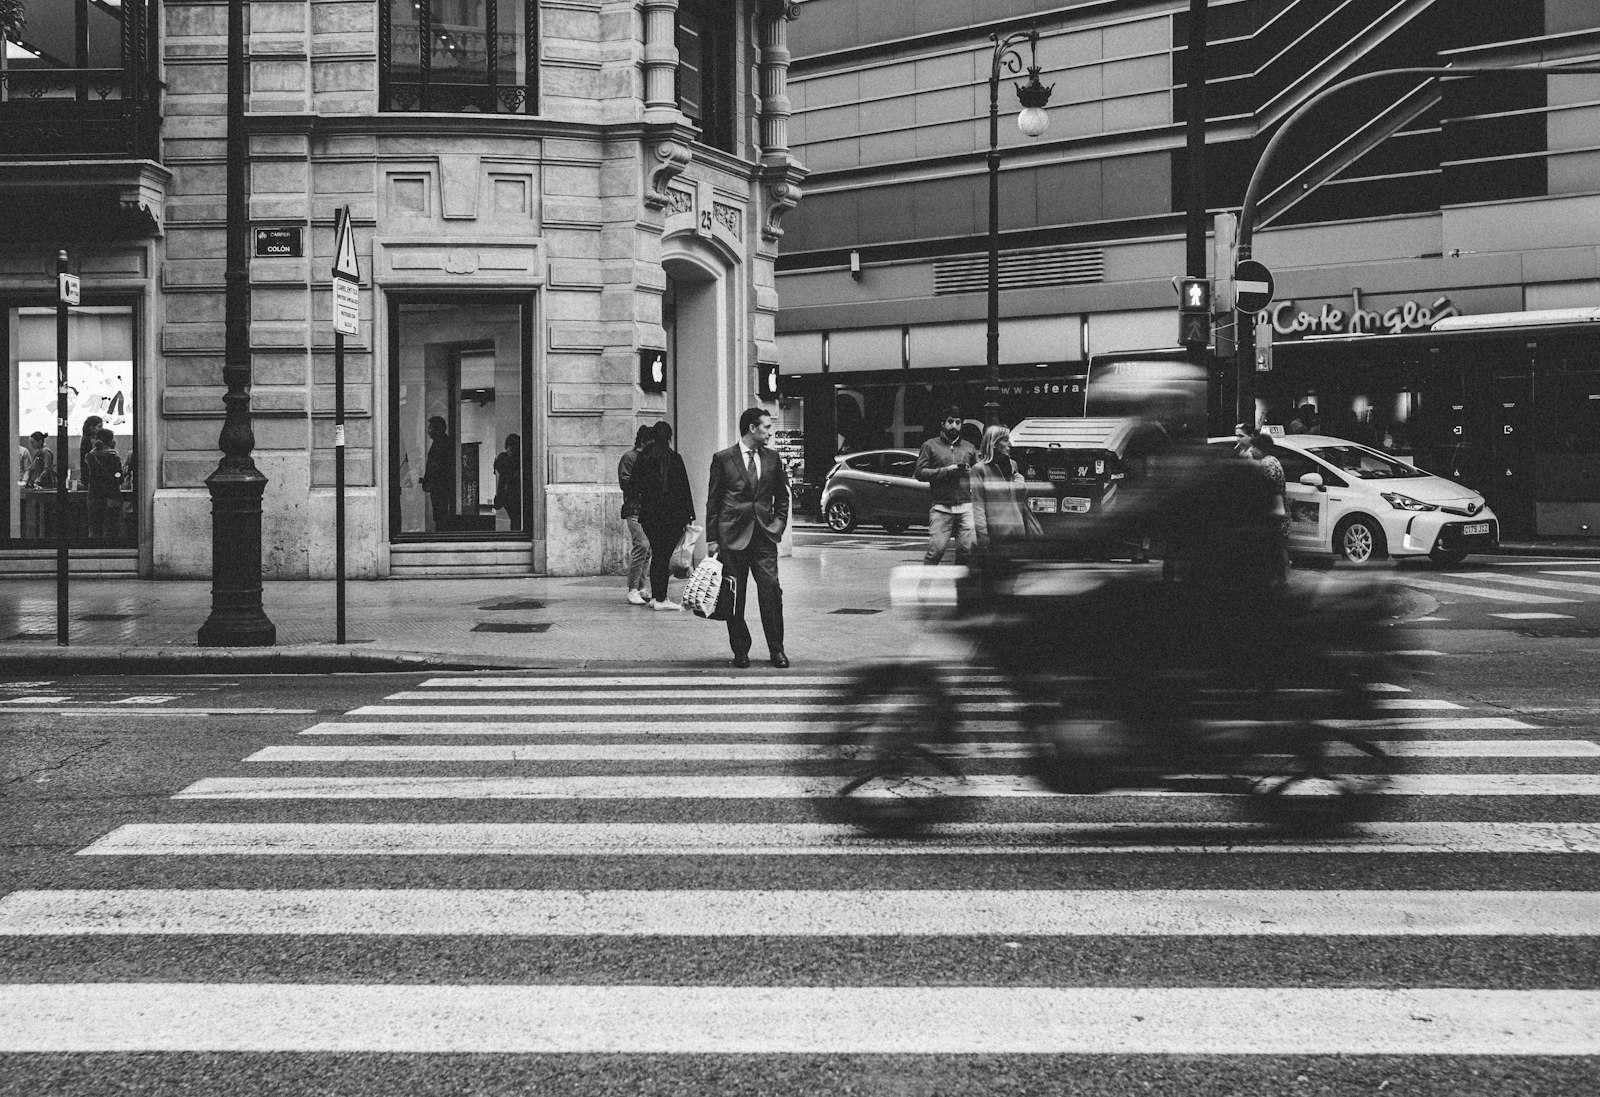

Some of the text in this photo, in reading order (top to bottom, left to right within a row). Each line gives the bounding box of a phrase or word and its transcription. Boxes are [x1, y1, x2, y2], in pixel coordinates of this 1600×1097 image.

[701, 210, 712, 230] 25
[267, 244, 290, 252] COLÓN
[1272, 301, 1342, 334] Corte
